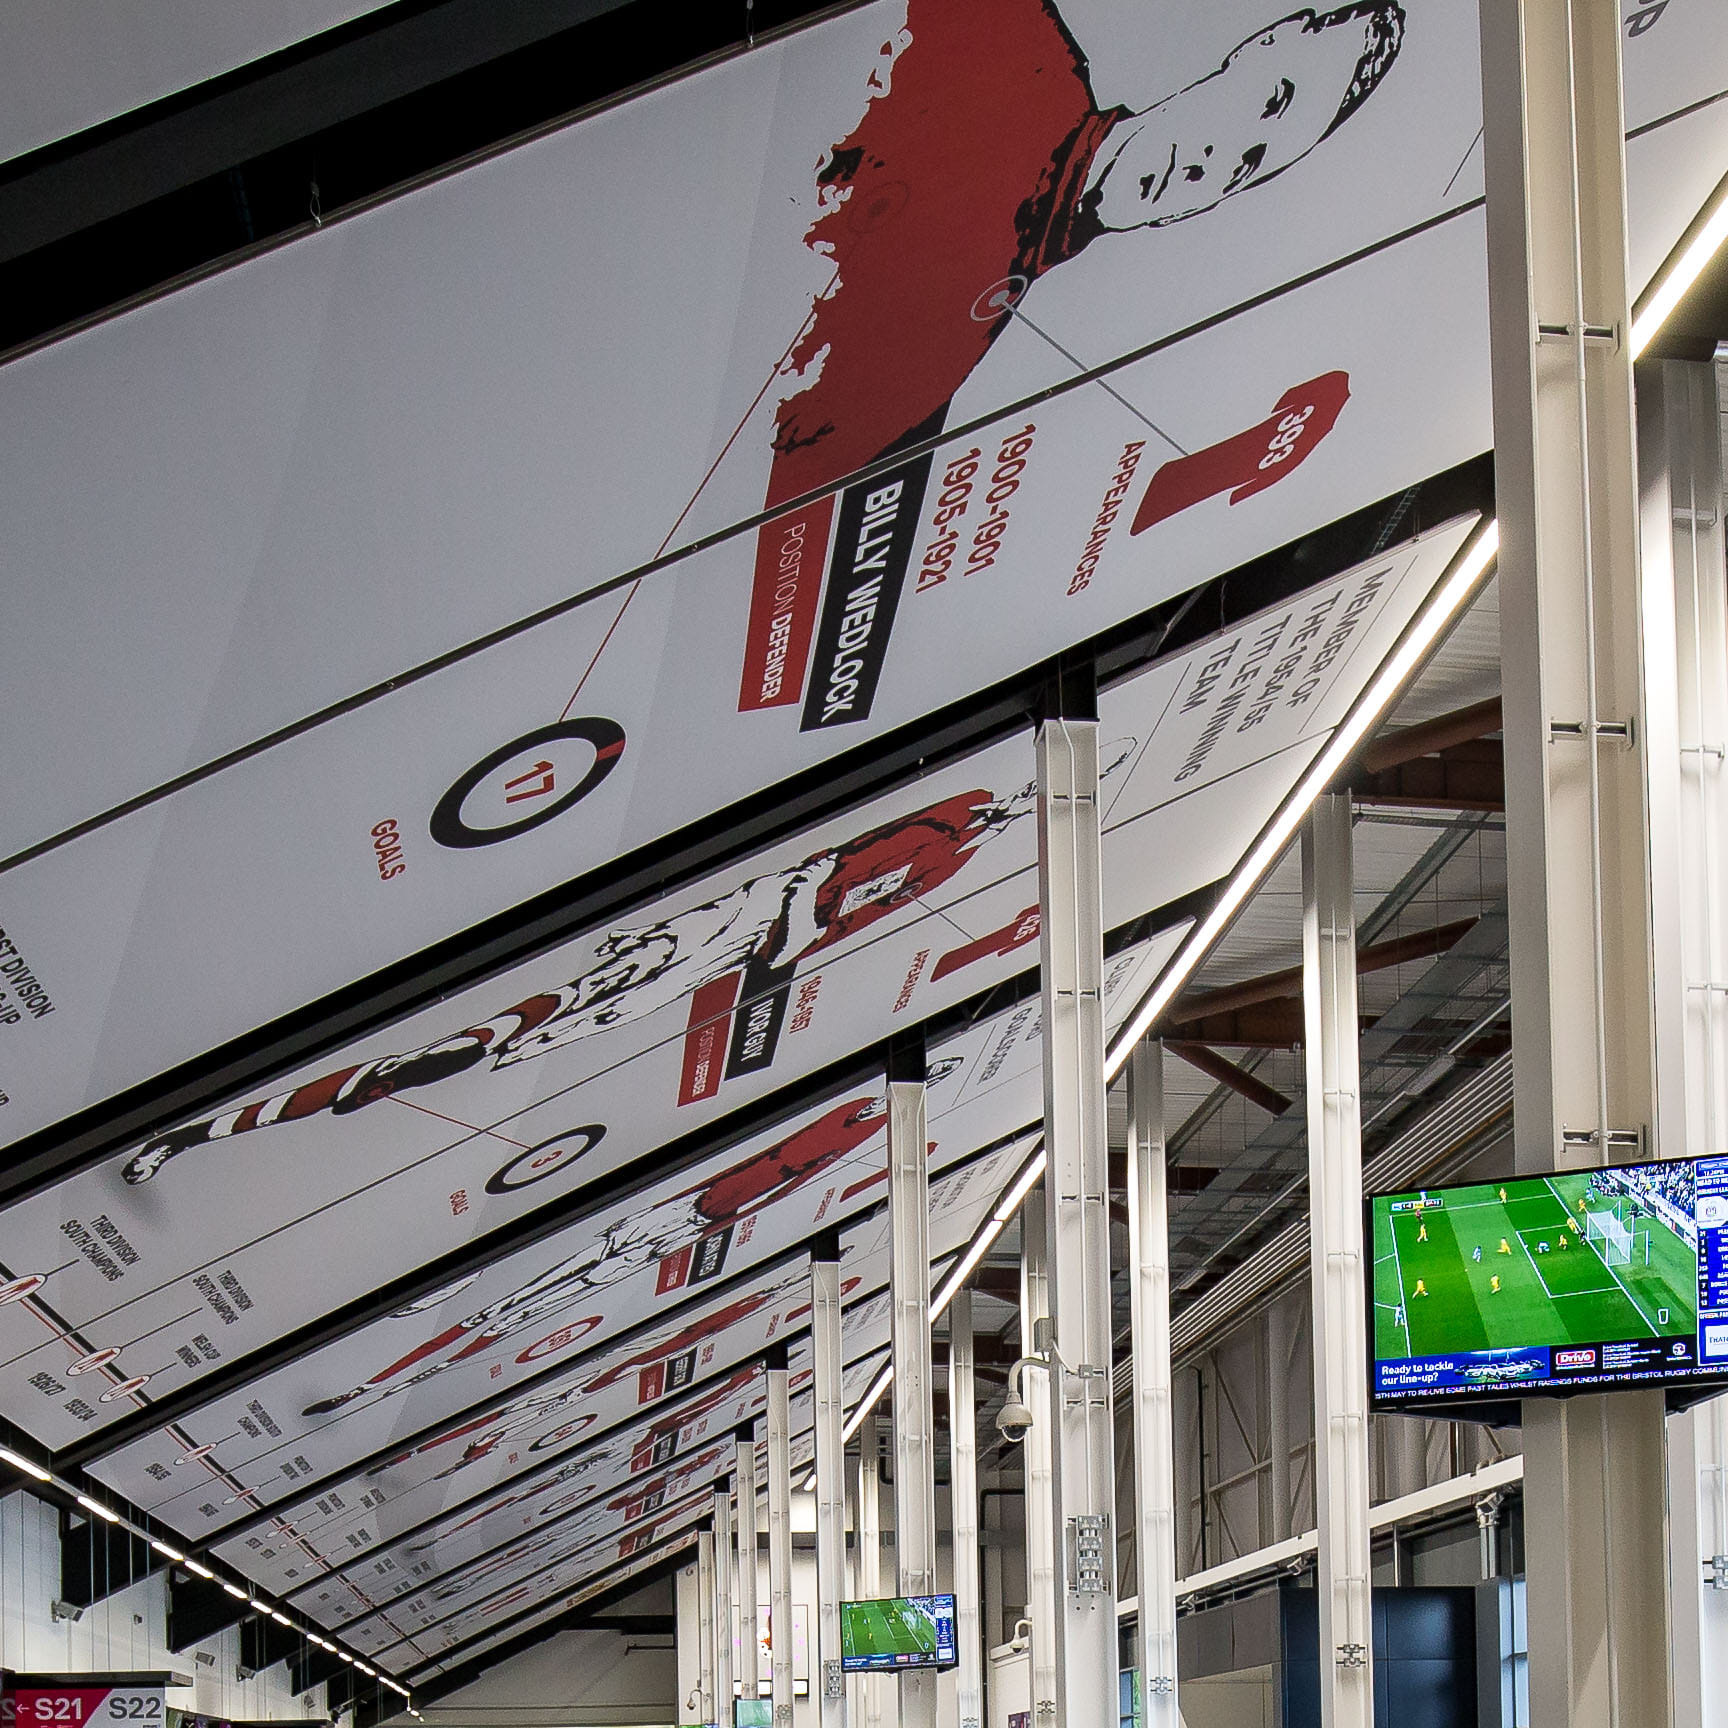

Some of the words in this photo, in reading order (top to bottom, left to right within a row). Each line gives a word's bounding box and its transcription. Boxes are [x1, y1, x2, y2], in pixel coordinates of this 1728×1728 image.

[1258, 404, 1315, 470] 393
[852, 479, 904, 575] BILLY
[915, 447, 983, 594] 1905-1921
[964, 423, 1036, 577] 1900-1901
[1066, 440, 1147, 597] APPEARANCES
[772, 521, 807, 616] POSITION
[821, 573, 884, 724] WEDLOCK
[1293, 588, 1344, 647] THE
[1314, 565, 1394, 679] MEMBER
[760, 612, 793, 703] DEFENDER
[1180, 637, 1243, 715] TEAM
[1236, 613, 1293, 687] TITLE
[1236, 645, 1303, 734] 1954/55
[1286, 677, 1323, 708] OF
[1173, 685, 1247, 783] WINNING
[505, 760, 554, 804] 17
[370, 818, 406, 881] GOALS
[0, 957, 56, 1019] DIVISION
[741, 1030, 763, 1062] GUY
[531, 1150, 563, 1168] 3
[60, 1219, 94, 1248] SOUTH
[90, 1214, 118, 1239] THIRD
[106, 1235, 141, 1266] DIVISION
[1381, 1364, 1411, 1377] Ready
[1413, 1364, 1423, 1373] to
[1425, 1361, 1454, 1372] tackle
[1381, 1376, 1398, 1386] our
[1400, 1372, 1439, 1385] line-up?
[1599, 1374, 1615, 1382] FOR
[1664, 1368, 1690, 1377] RUGBY
[35, 1698, 82, 1720] S21
[109, 1697, 161, 1719] S22
